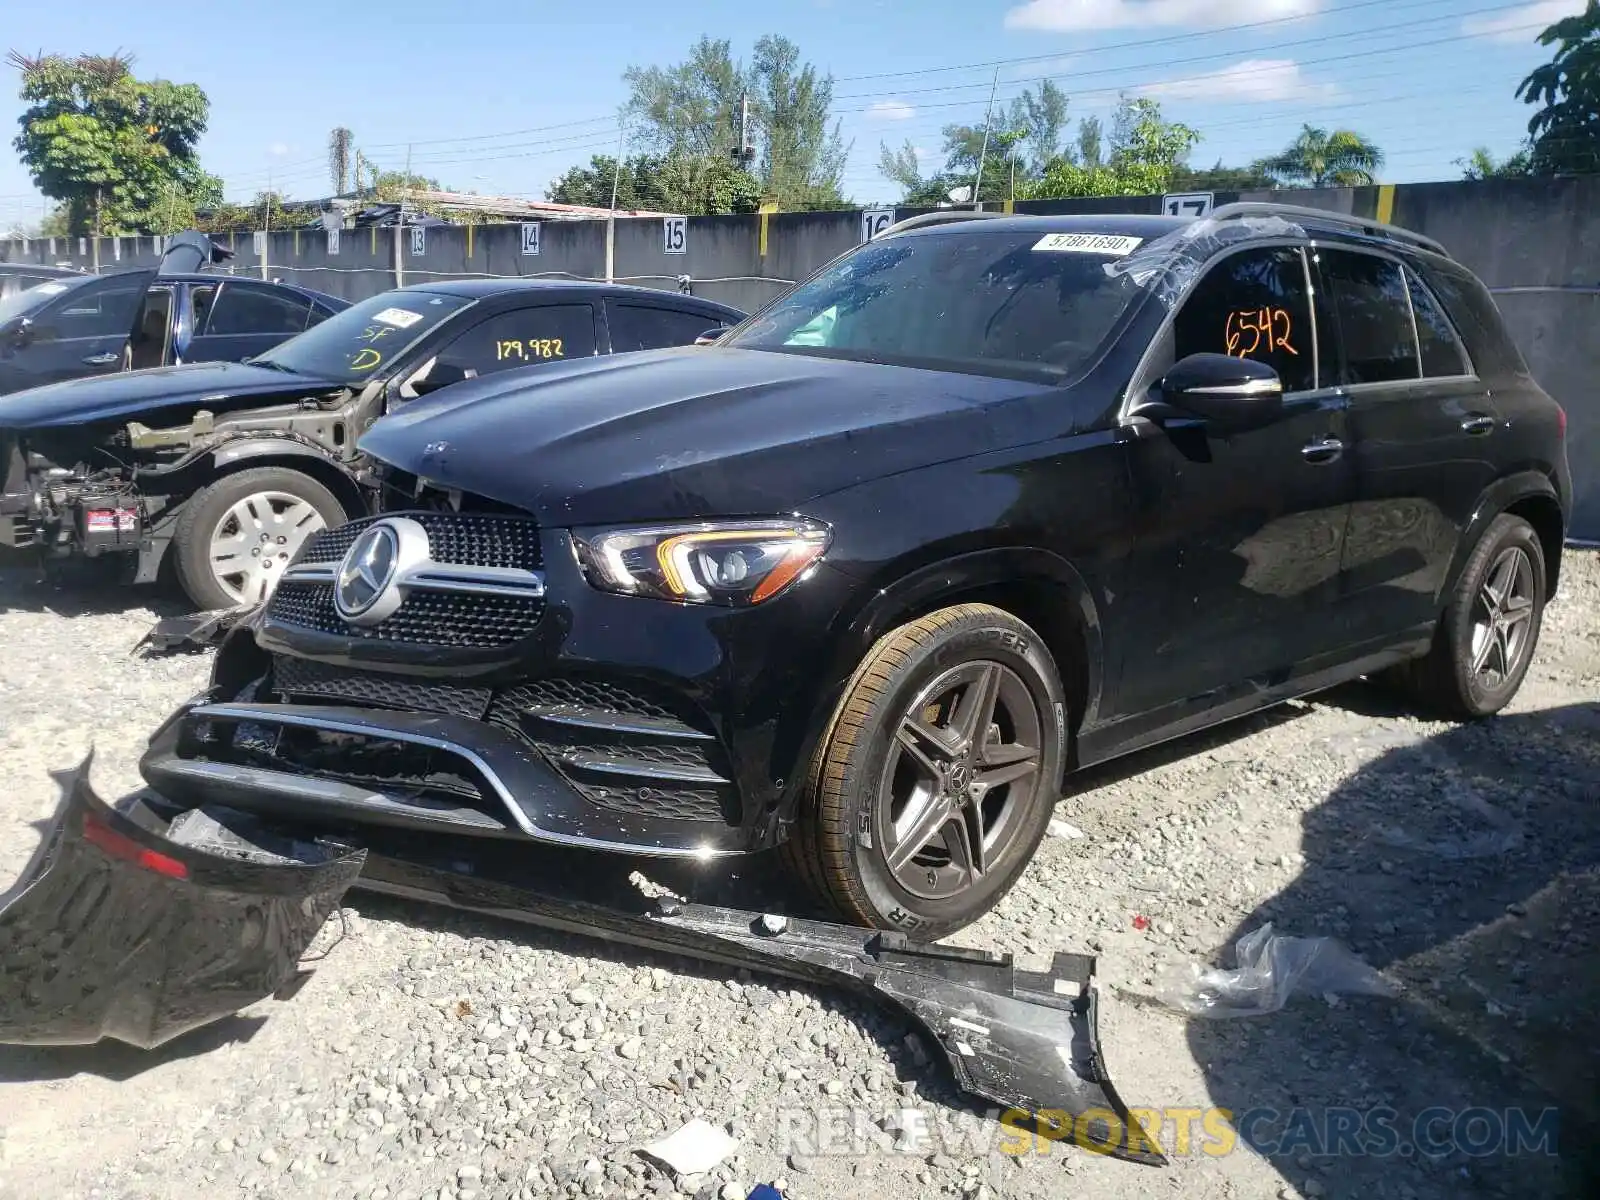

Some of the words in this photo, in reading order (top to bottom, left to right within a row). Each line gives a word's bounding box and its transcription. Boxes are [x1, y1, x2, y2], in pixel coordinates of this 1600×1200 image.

[413, 230, 424, 252] 13
[523, 226, 537, 251] 14
[666, 221, 684, 249] 15
[350, 348, 381, 369] D
